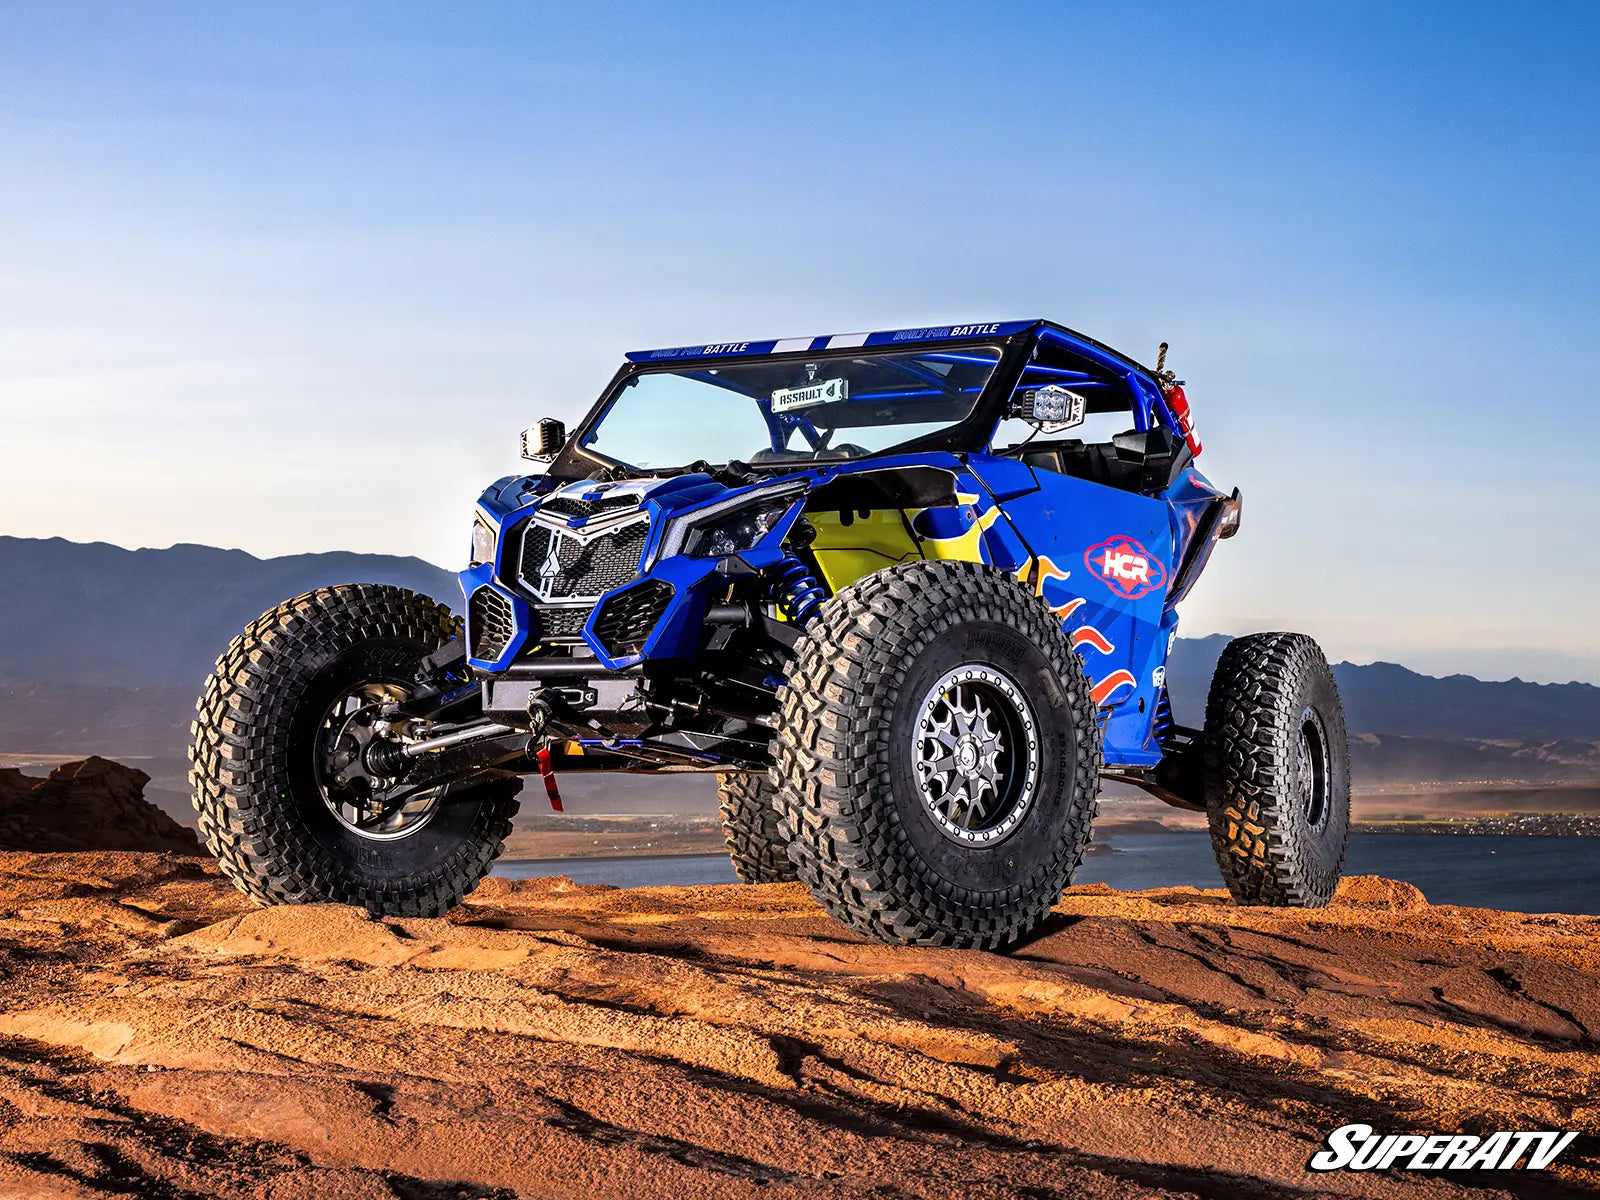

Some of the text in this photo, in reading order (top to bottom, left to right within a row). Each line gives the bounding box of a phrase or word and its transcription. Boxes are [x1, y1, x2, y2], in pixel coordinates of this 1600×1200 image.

[893, 328, 927, 340] BUILT
[950, 323, 1000, 336] BATTLE
[703, 343, 749, 355] BATTLE
[780, 387, 823, 405] ASSAULT
[1103, 550, 1149, 584] HCR
